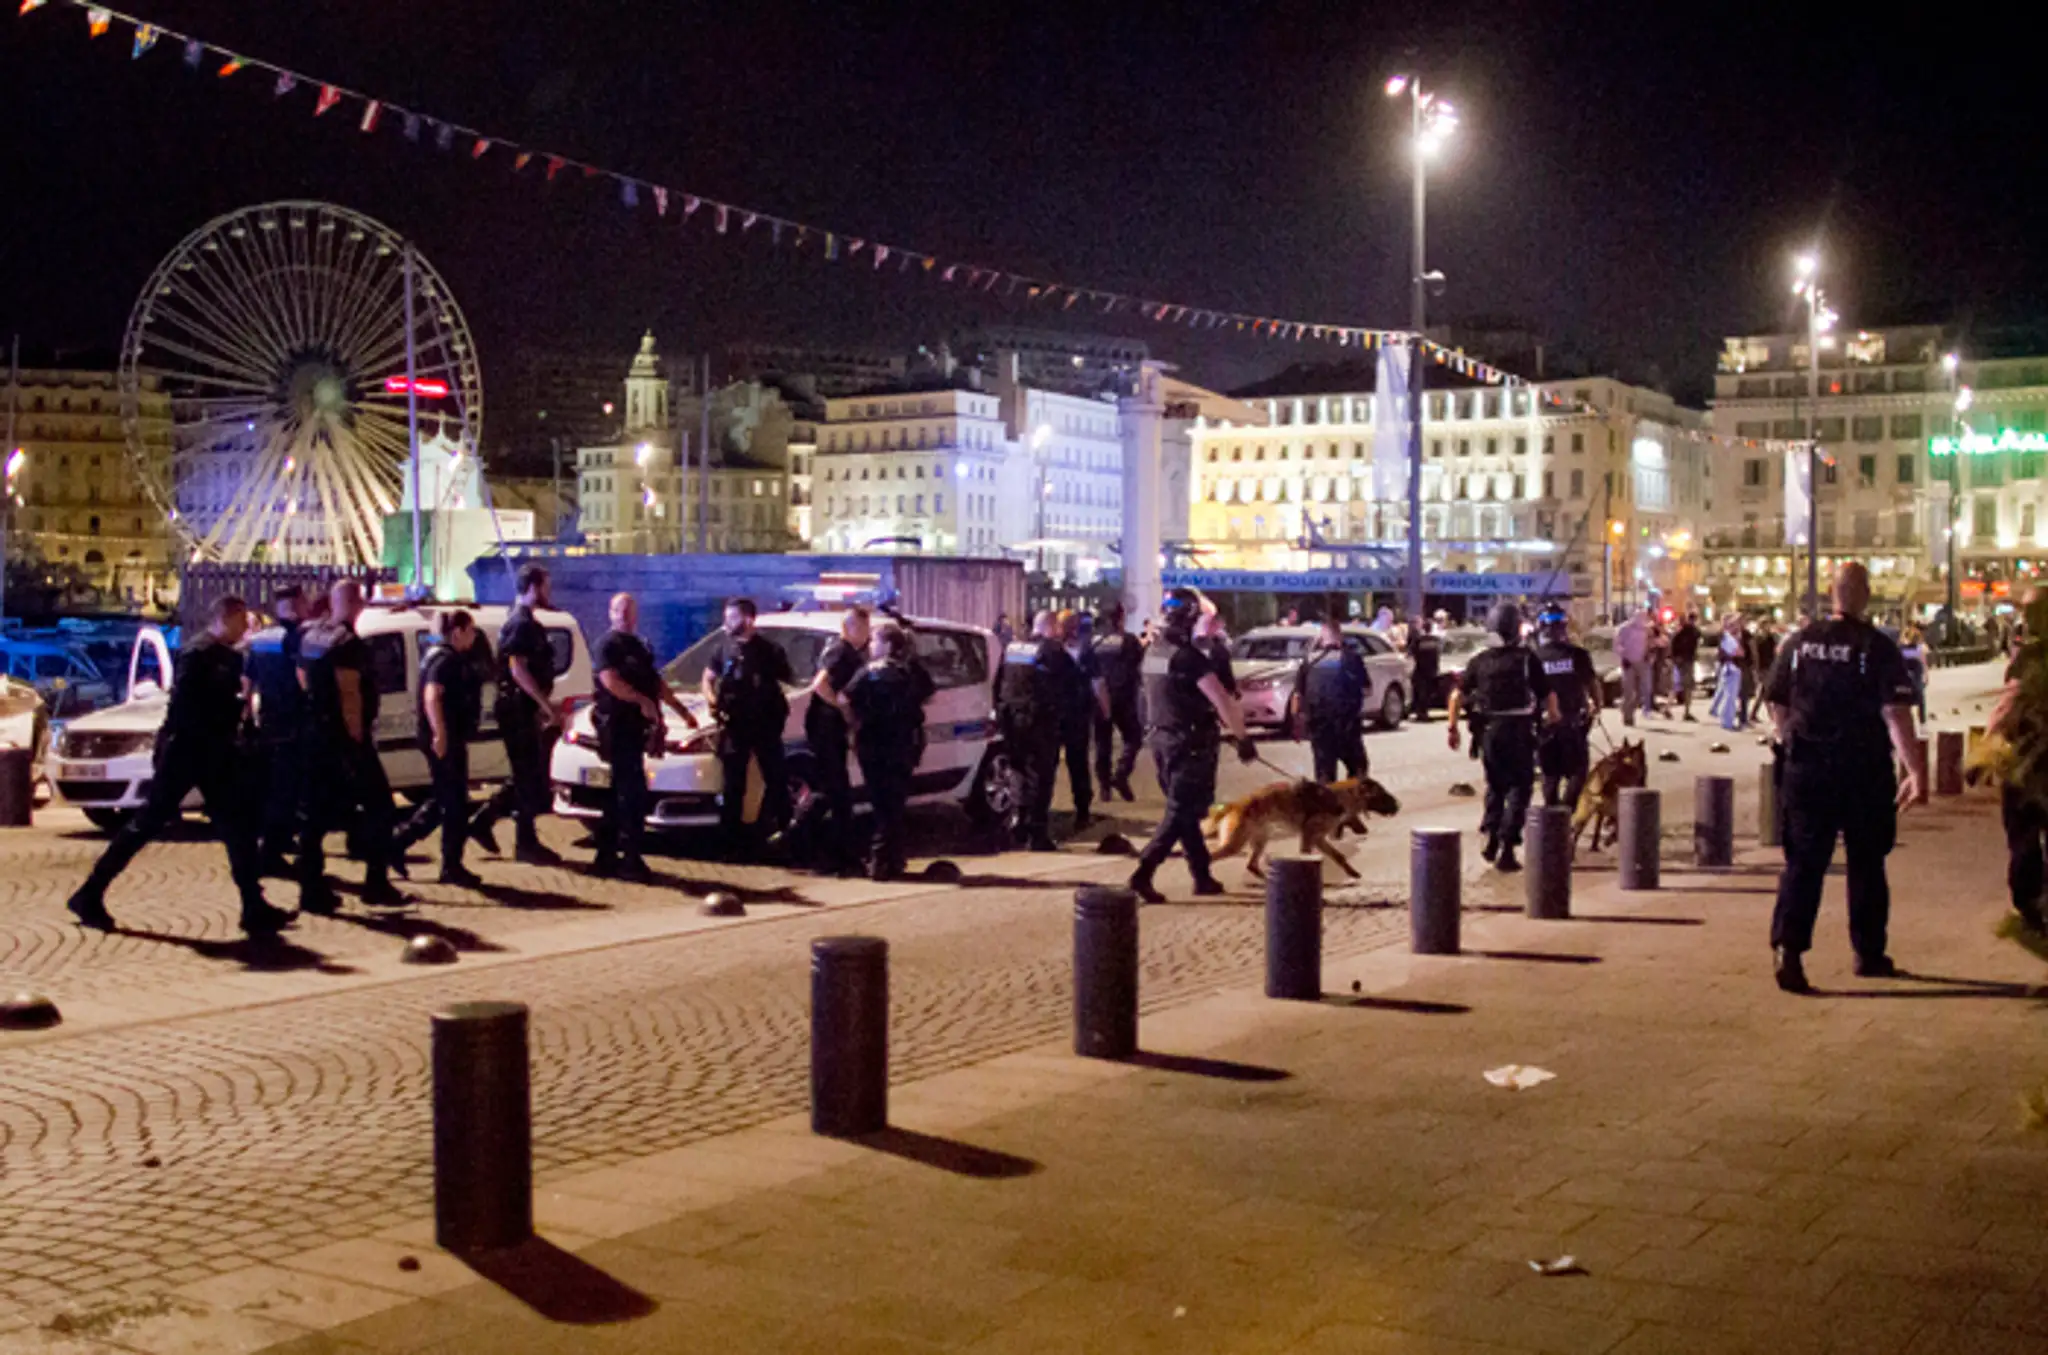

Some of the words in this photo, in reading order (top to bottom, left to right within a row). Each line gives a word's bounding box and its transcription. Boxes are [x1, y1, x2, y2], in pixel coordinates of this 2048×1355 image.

[1161, 573, 1265, 587] NAVETTES
[1272, 575, 1330, 588] POUR
[1801, 642, 1850, 662] POLICE
